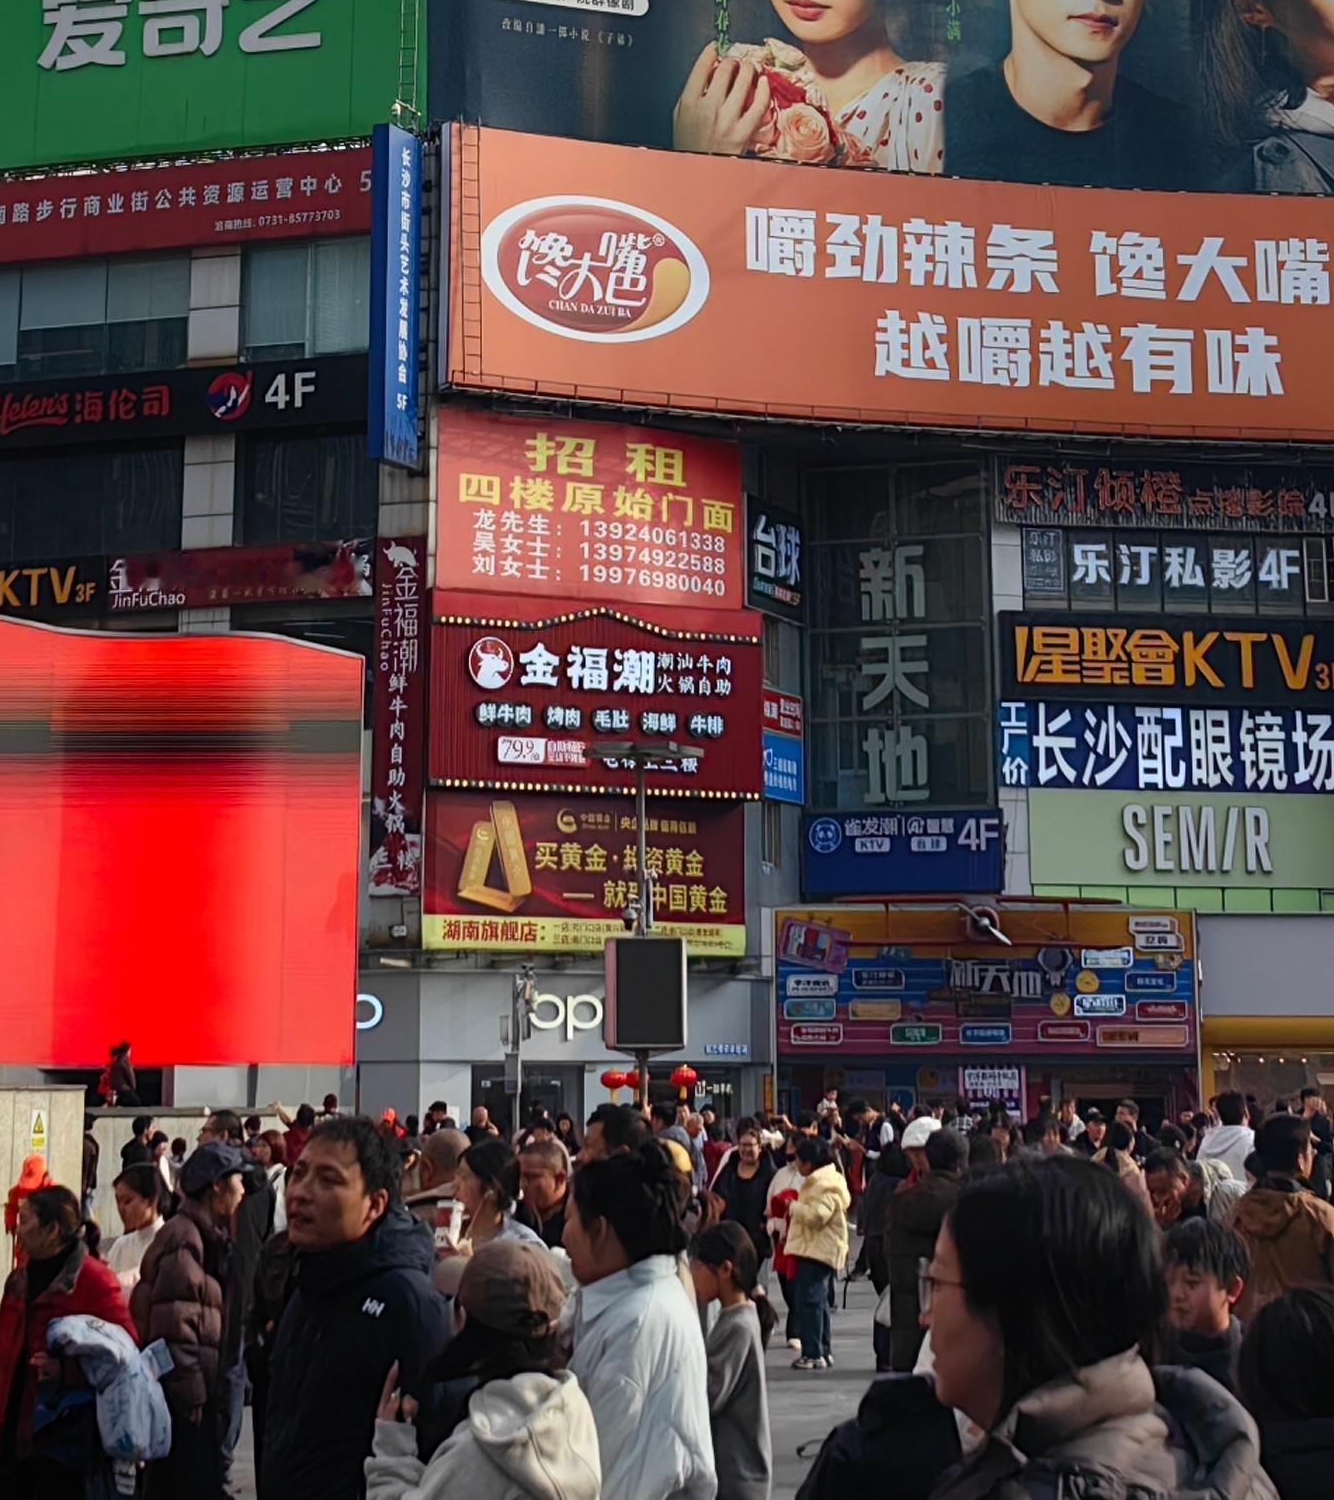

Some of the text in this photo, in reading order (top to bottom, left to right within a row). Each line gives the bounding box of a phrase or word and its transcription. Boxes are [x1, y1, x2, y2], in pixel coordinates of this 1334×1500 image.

[745, 205, 1060, 295] 嚼劲辣条
[549, 300, 632, 318] CHAN DA ZUI BA
[875, 308, 1284, 396] 越嚼越有味
[74, 385, 171, 425] 海伦司
[265, 371, 316, 410] 4F
[525, 432, 686, 487] 招租
[459, 473, 735, 533] 四楼原始门面
[580, 520, 725, 552] 13924061338
[580, 541, 725, 574] 13974922588
[754, 514, 801, 585] 台球
[580, 564, 725, 596] 19976980040
[1072, 544, 1252, 589] 乐汀私影
[1258, 550, 1300, 590] 4F
[76, 583, 98, 604] 3F
[112, 592, 186, 610] JinFuChao
[394, 566, 418, 672] 金福潮
[519, 642, 731, 694] 金福潮 潮汕牛肉
[859, 545, 930, 804] 新天地
[1020, 626, 1315, 690] 星聚會KTV
[658, 675, 731, 696] 火锅自助
[478, 703, 532, 724] 鲜牛肉
[546, 706, 581, 727] 烤肉
[594, 710, 630, 729] 毛肚
[690, 714, 724, 735] 牛排
[1001, 702, 1028, 784] 工厂价
[386, 673, 409, 833] 鲜牛肉自助火锅
[861, 839, 884, 849] KTV
[958, 819, 999, 851] 4F
